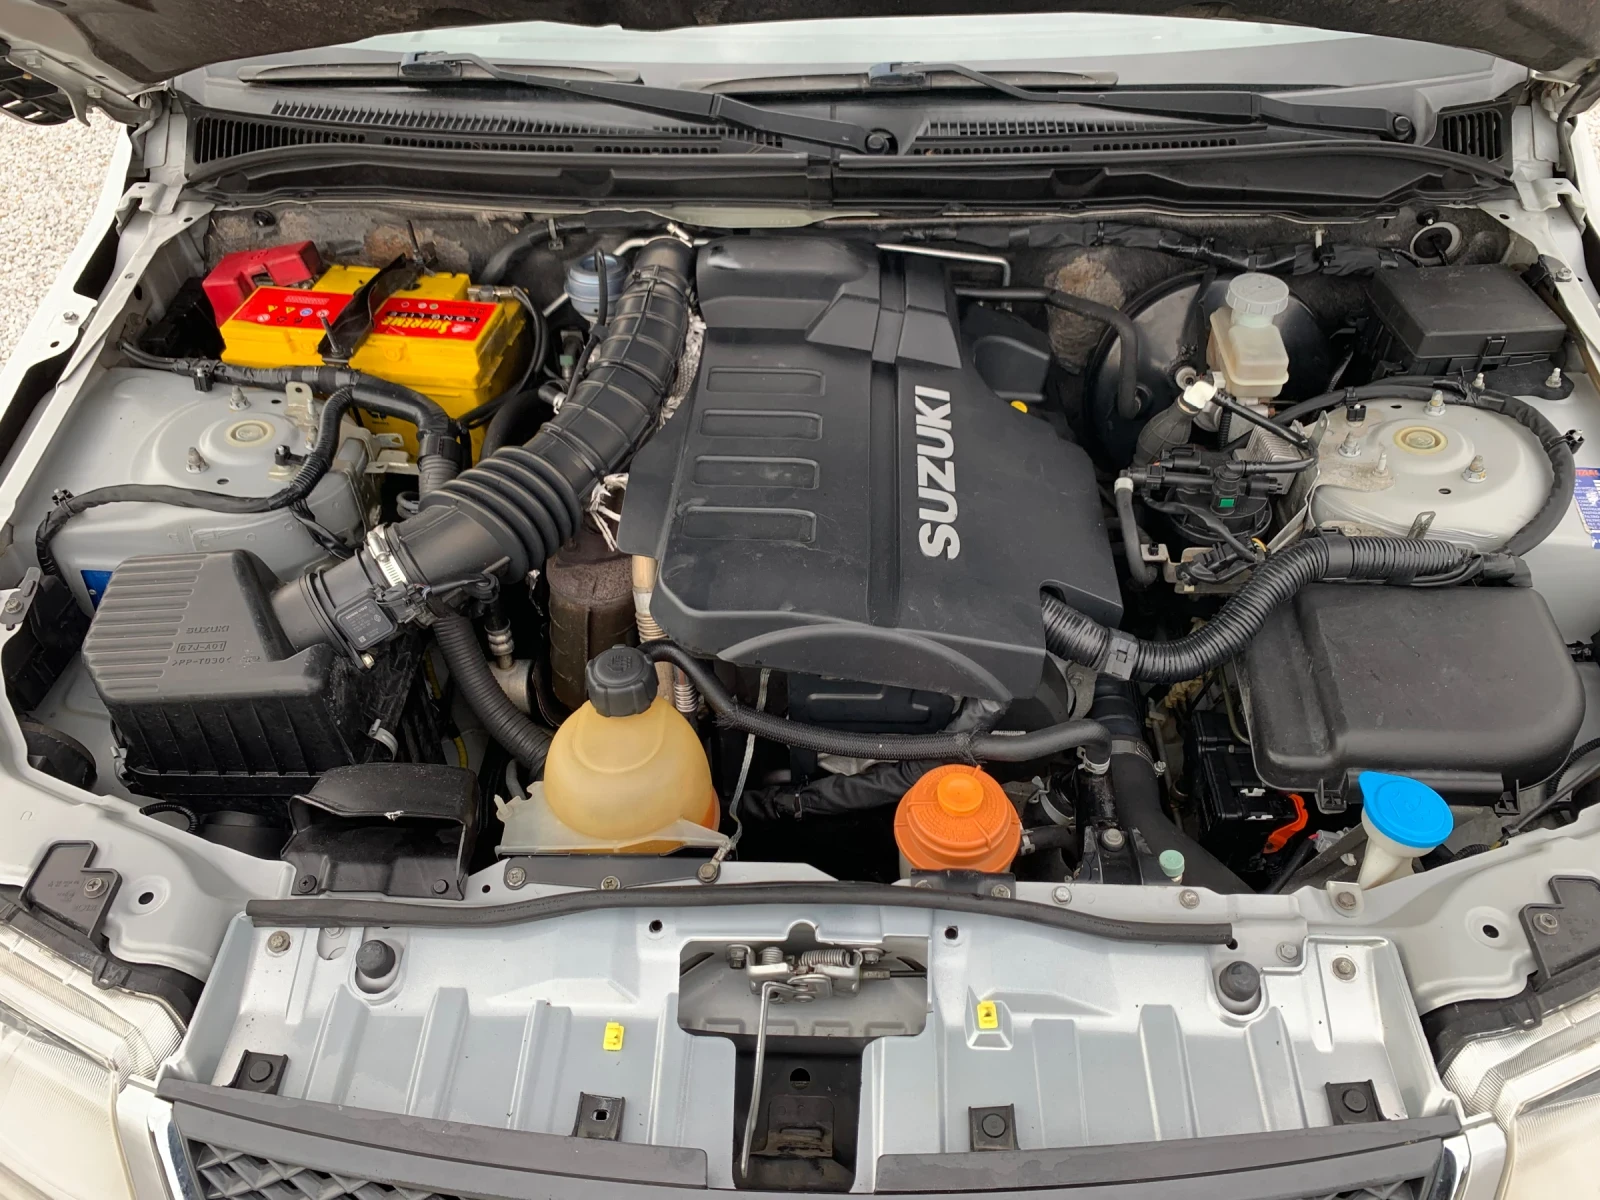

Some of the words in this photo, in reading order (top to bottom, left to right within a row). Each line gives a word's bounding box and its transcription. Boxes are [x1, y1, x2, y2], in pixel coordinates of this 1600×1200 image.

[389, 311, 425, 319] LIFE
[431, 313, 477, 323] LONG
[381, 316, 452, 334] SUPREME
[914, 385, 960, 560] SUZUKI
[186, 625, 230, 634] SUZUKI
[180, 643, 223, 652] 67J-A01
